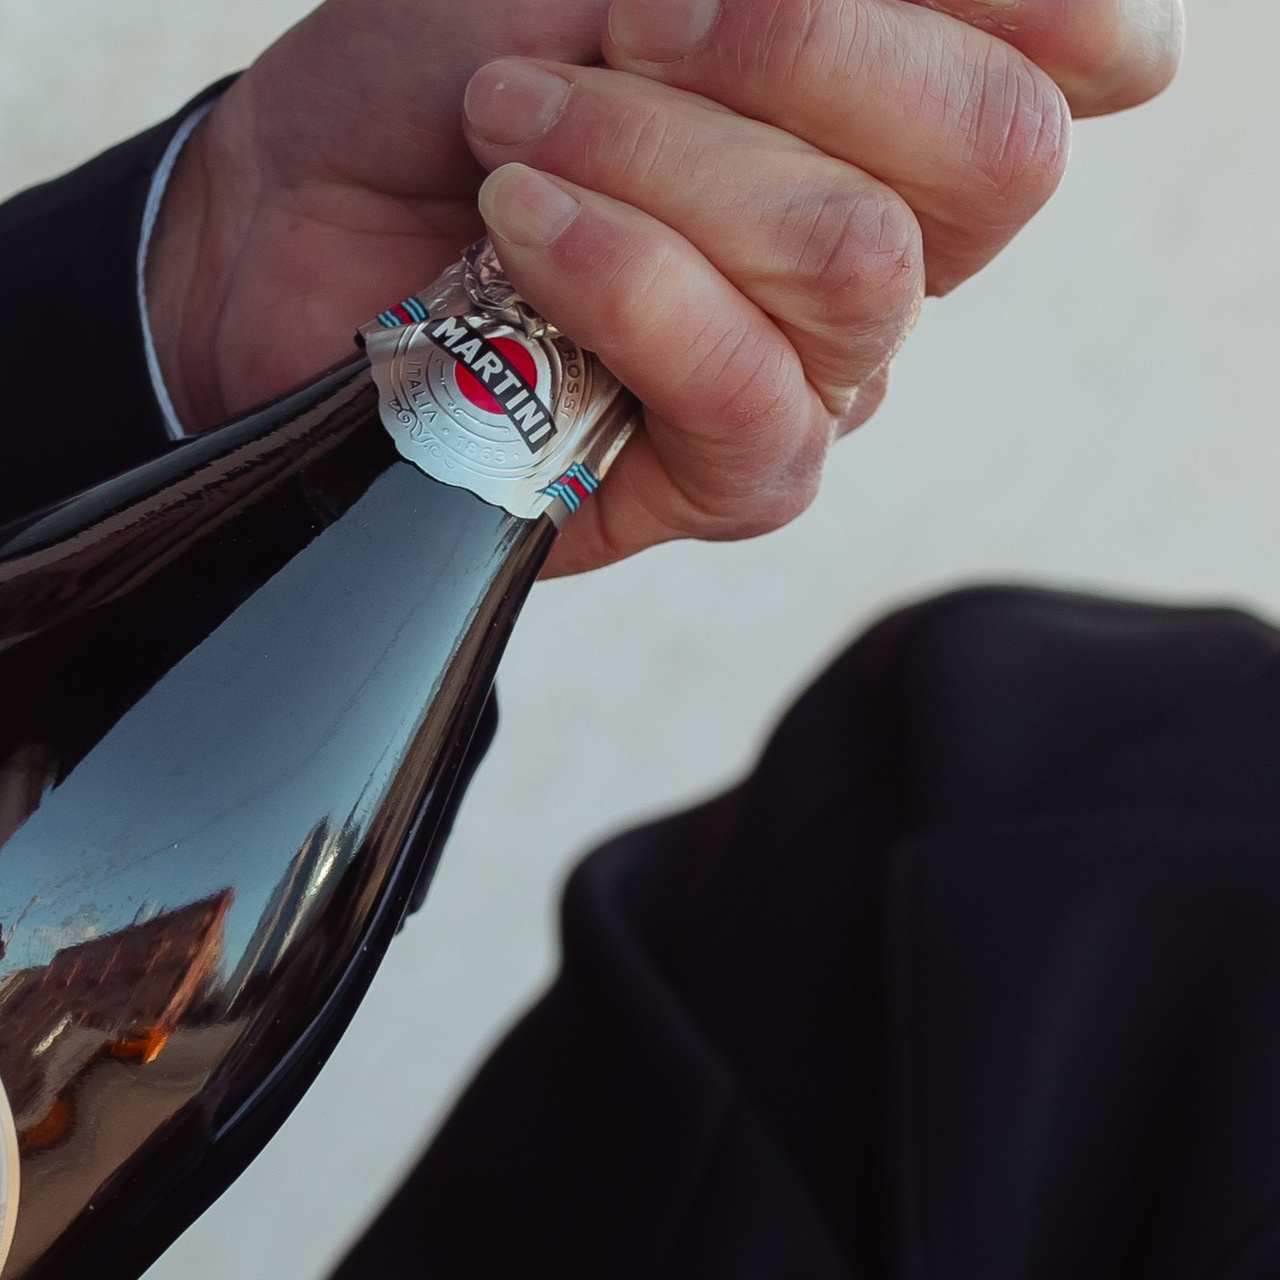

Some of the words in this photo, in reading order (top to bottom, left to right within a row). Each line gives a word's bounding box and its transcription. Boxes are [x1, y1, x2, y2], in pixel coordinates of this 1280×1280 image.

[408, 361, 438, 423] ITALIA
[431, 316, 552, 444] MARTINI
[562, 349, 580, 419] ROSSI
